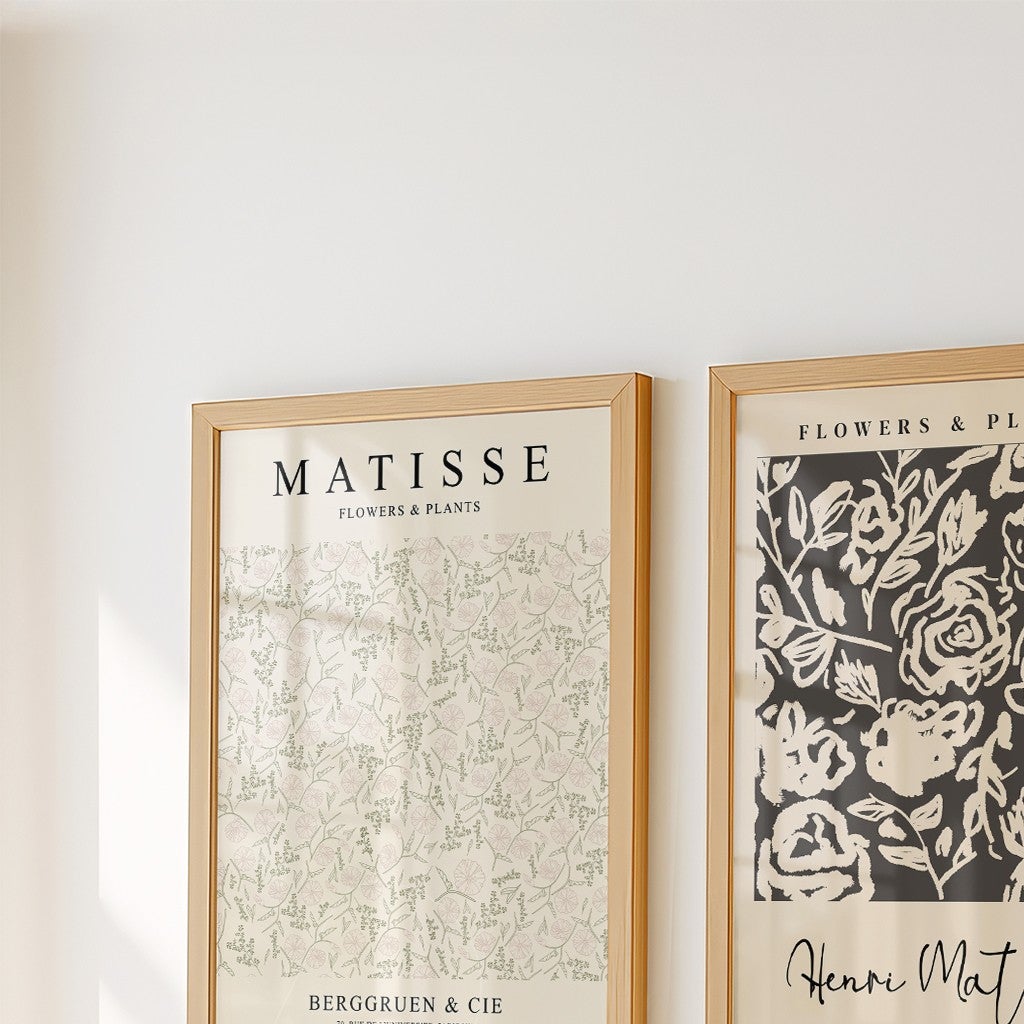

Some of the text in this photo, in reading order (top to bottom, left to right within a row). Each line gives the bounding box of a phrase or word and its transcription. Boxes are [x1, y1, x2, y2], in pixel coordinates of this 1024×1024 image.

[798, 417, 930, 441] FLOWERS
[950, 415, 966, 432] &
[272, 444, 550, 497] MATISSE
[339, 500, 481, 520] FLOWERS & PLANTS
[785, 938, 907, 1006] Henri
[308, 994, 503, 1015] BERGGRUEN & CIE
